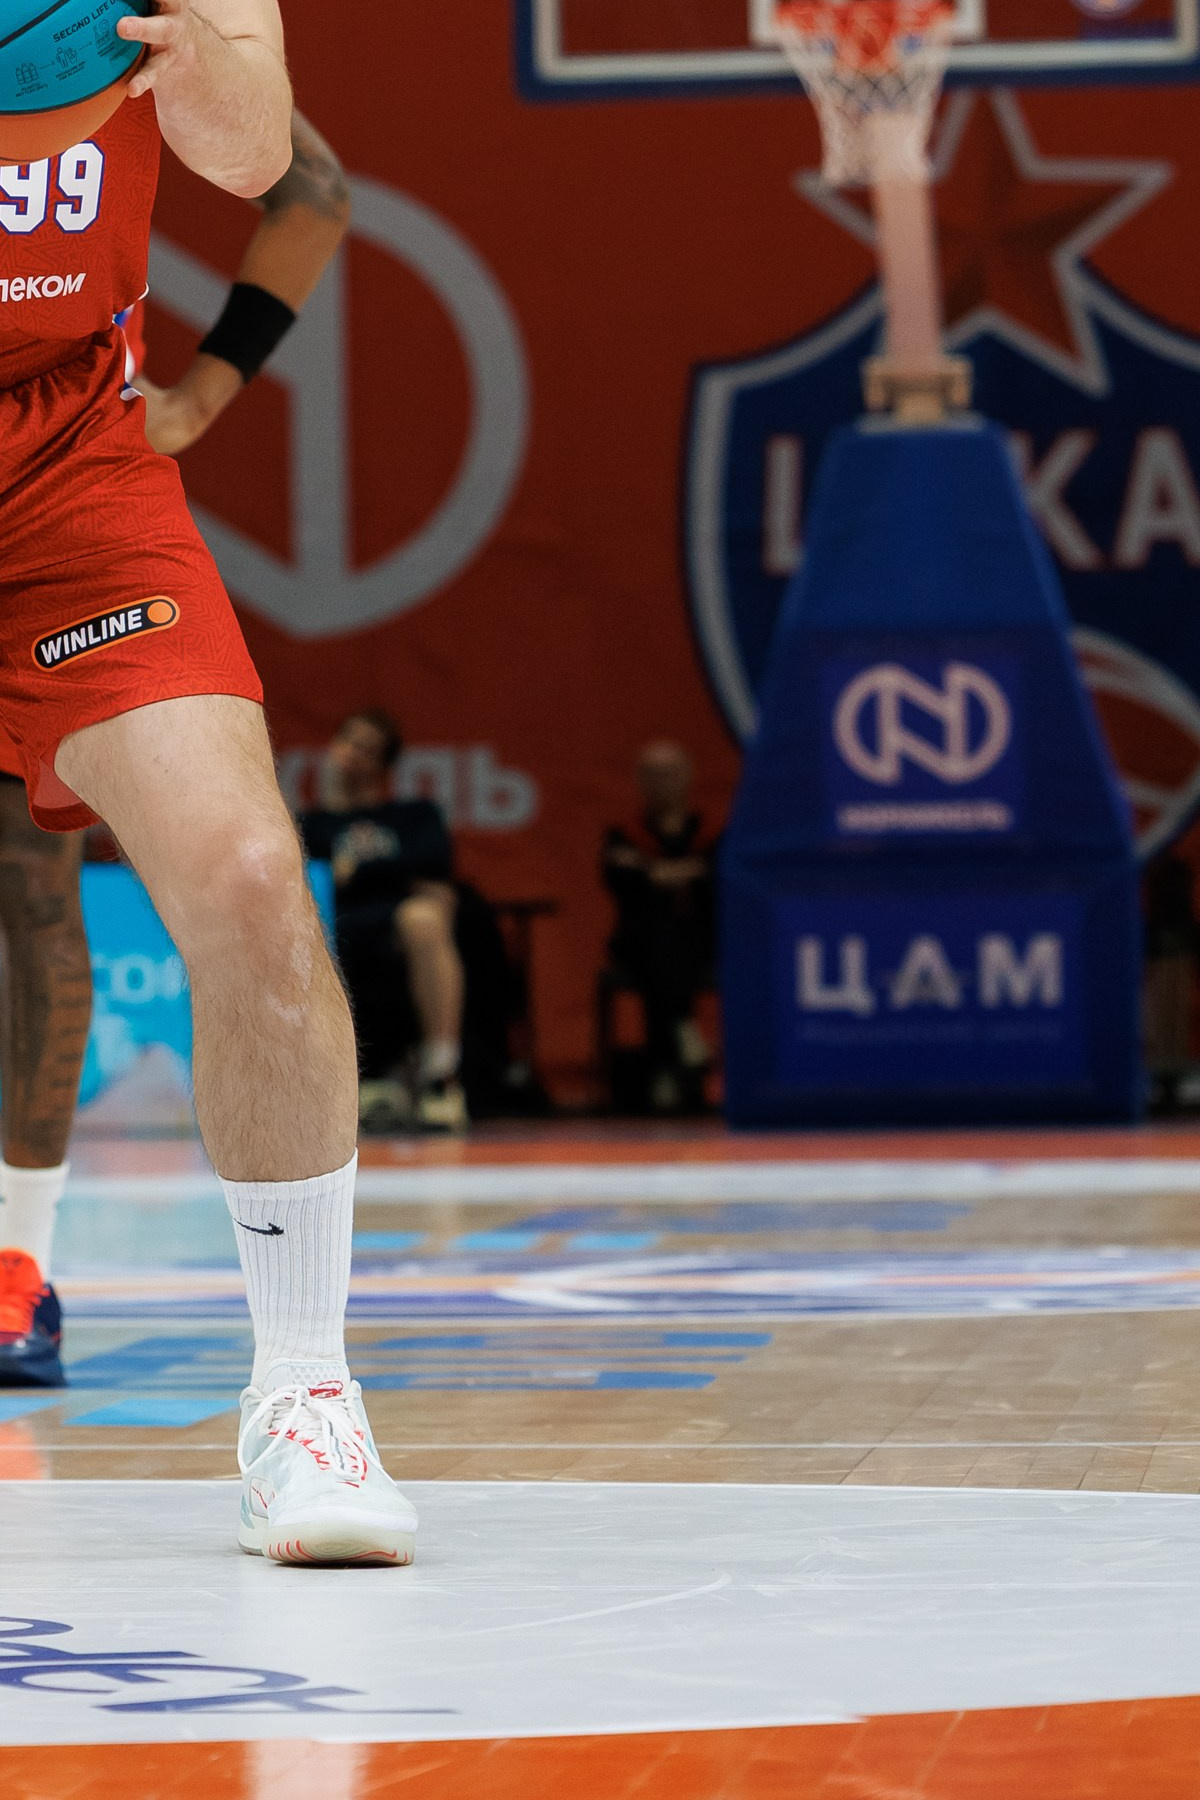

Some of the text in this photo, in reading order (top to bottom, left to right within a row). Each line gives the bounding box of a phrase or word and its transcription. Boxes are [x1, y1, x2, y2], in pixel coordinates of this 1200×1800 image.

[53, 16, 90, 43] SECOND
[91, 3, 111, 20] LIFE
[40, 607, 143, 664] WINLINE
